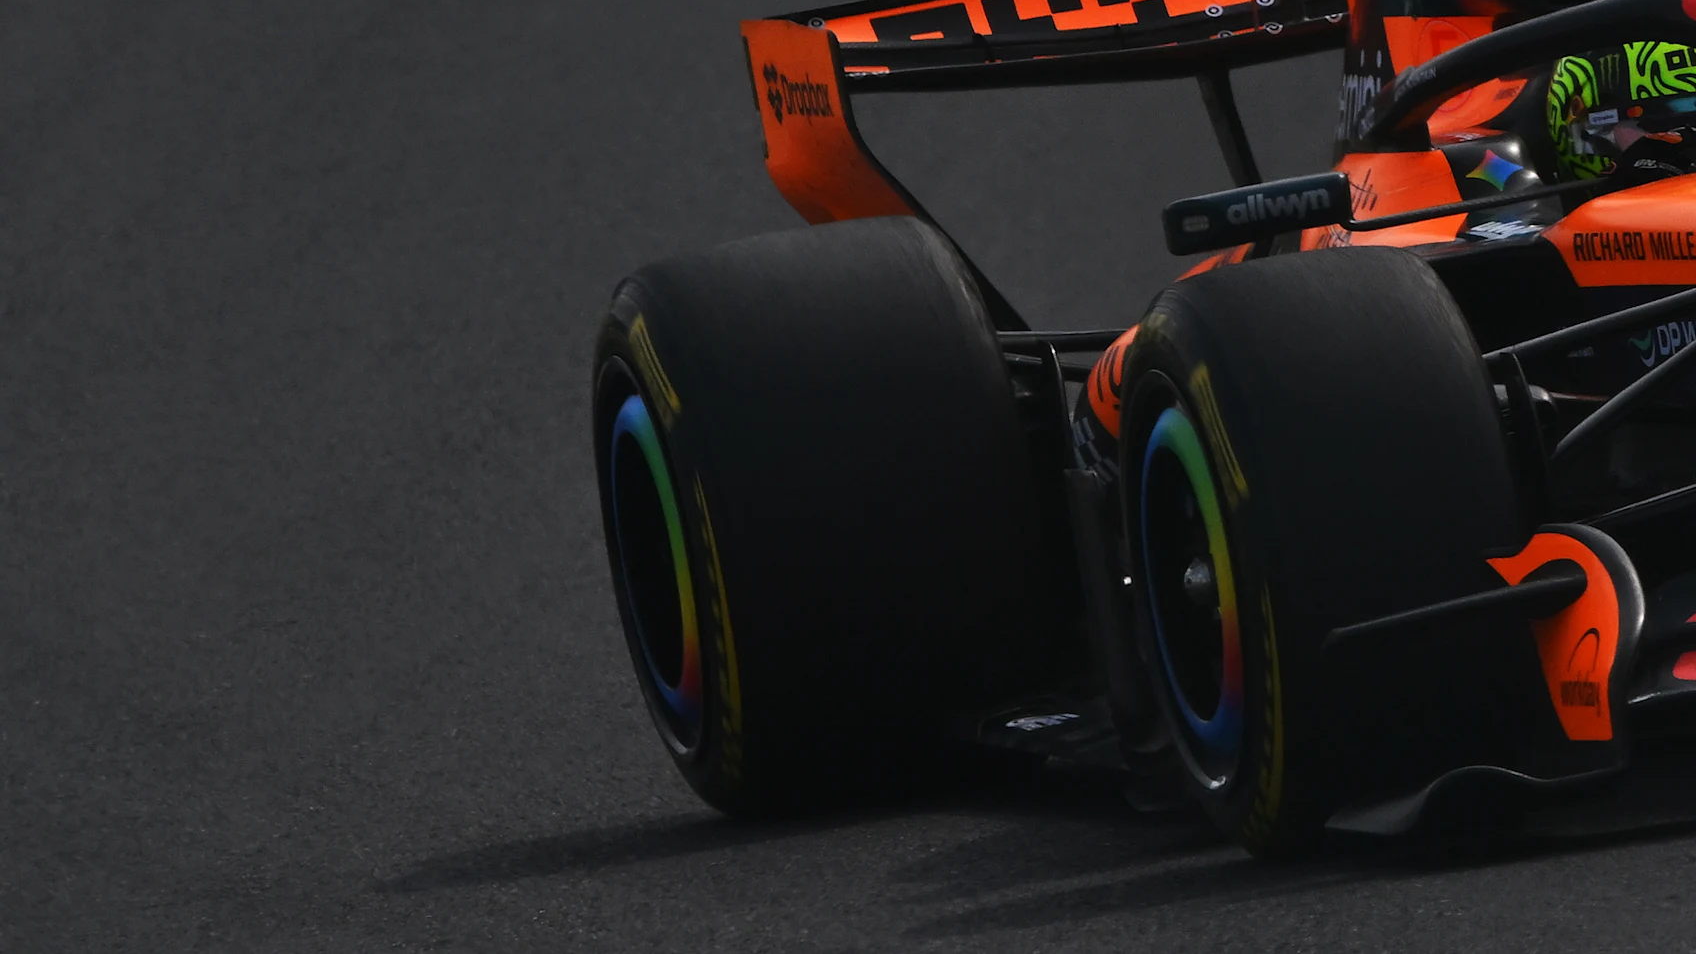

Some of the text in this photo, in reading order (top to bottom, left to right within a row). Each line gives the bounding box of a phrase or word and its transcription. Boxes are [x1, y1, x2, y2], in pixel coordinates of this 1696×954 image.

[781, 72, 833, 127] Dropbox
[1226, 188, 1330, 225] allwyn
[1574, 232, 1646, 261] RICHARD
[1656, 321, 1681, 356] DP
